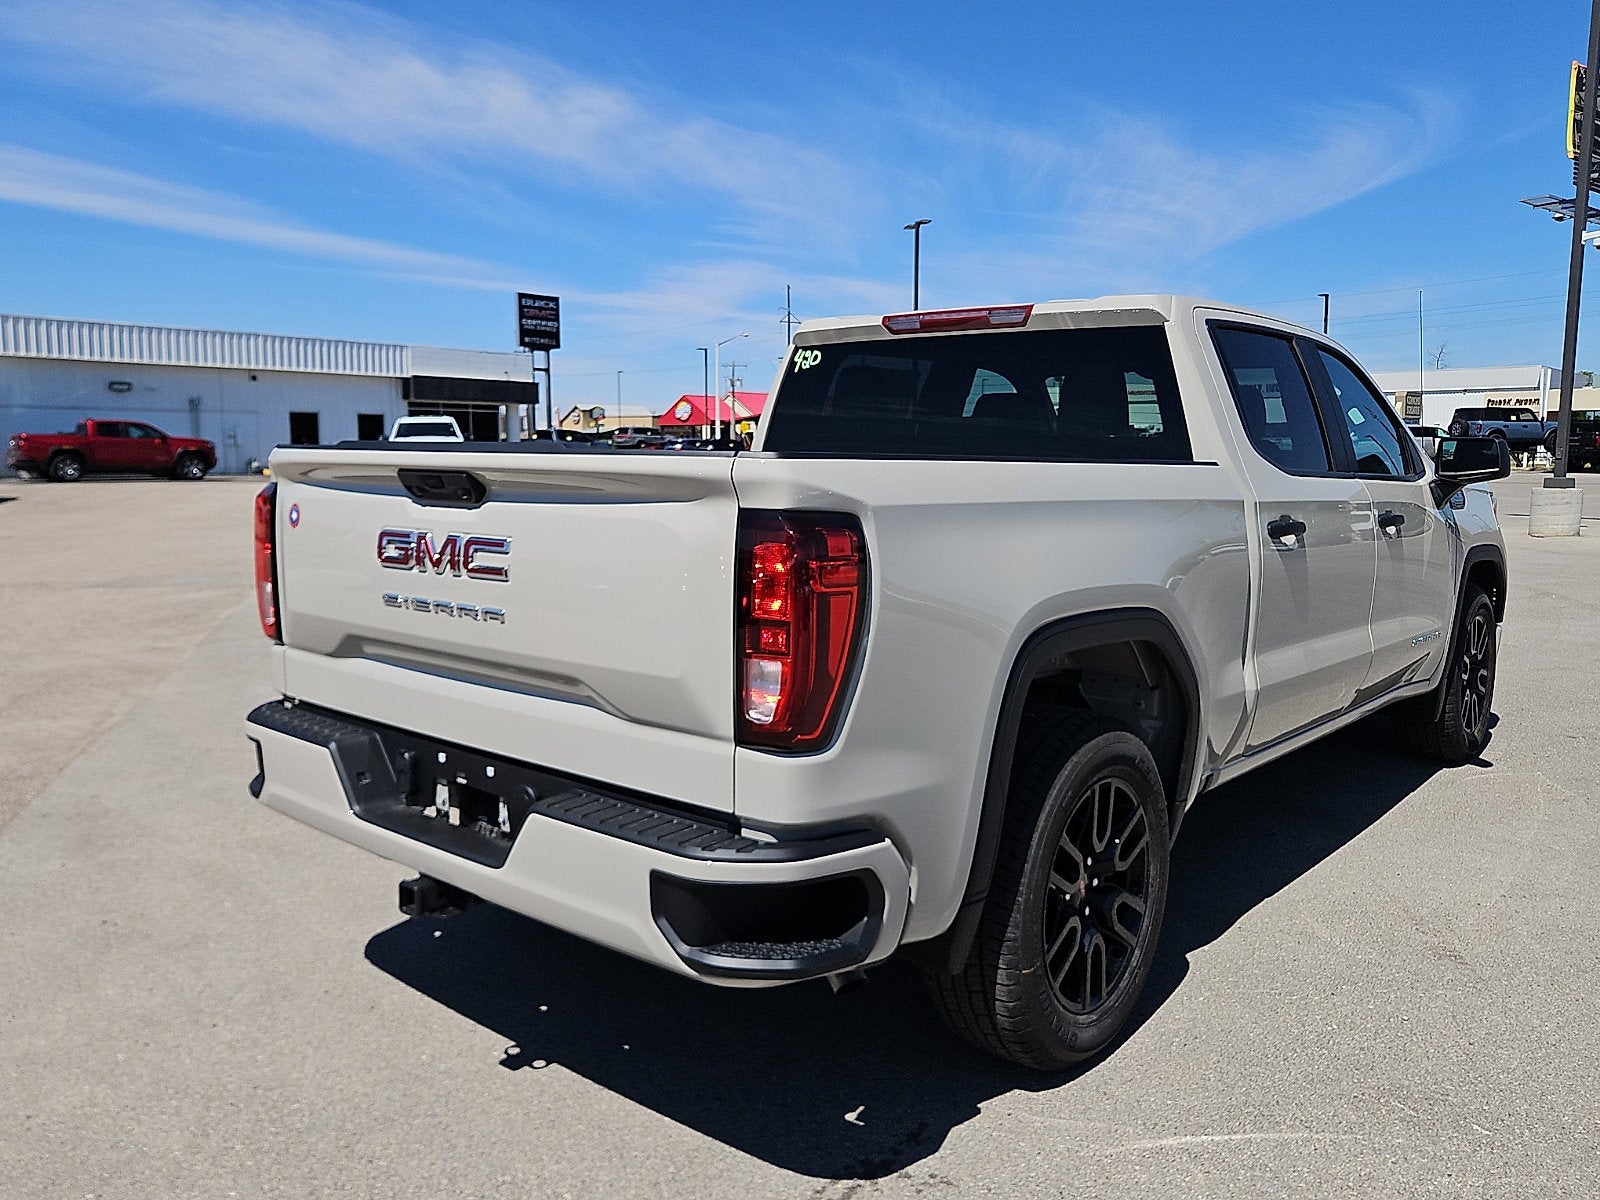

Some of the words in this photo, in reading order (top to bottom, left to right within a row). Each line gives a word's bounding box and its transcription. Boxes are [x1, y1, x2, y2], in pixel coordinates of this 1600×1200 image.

[794, 348, 822, 373] 420
[377, 526, 513, 582] GMC
[382, 591, 506, 625] SIERRA
